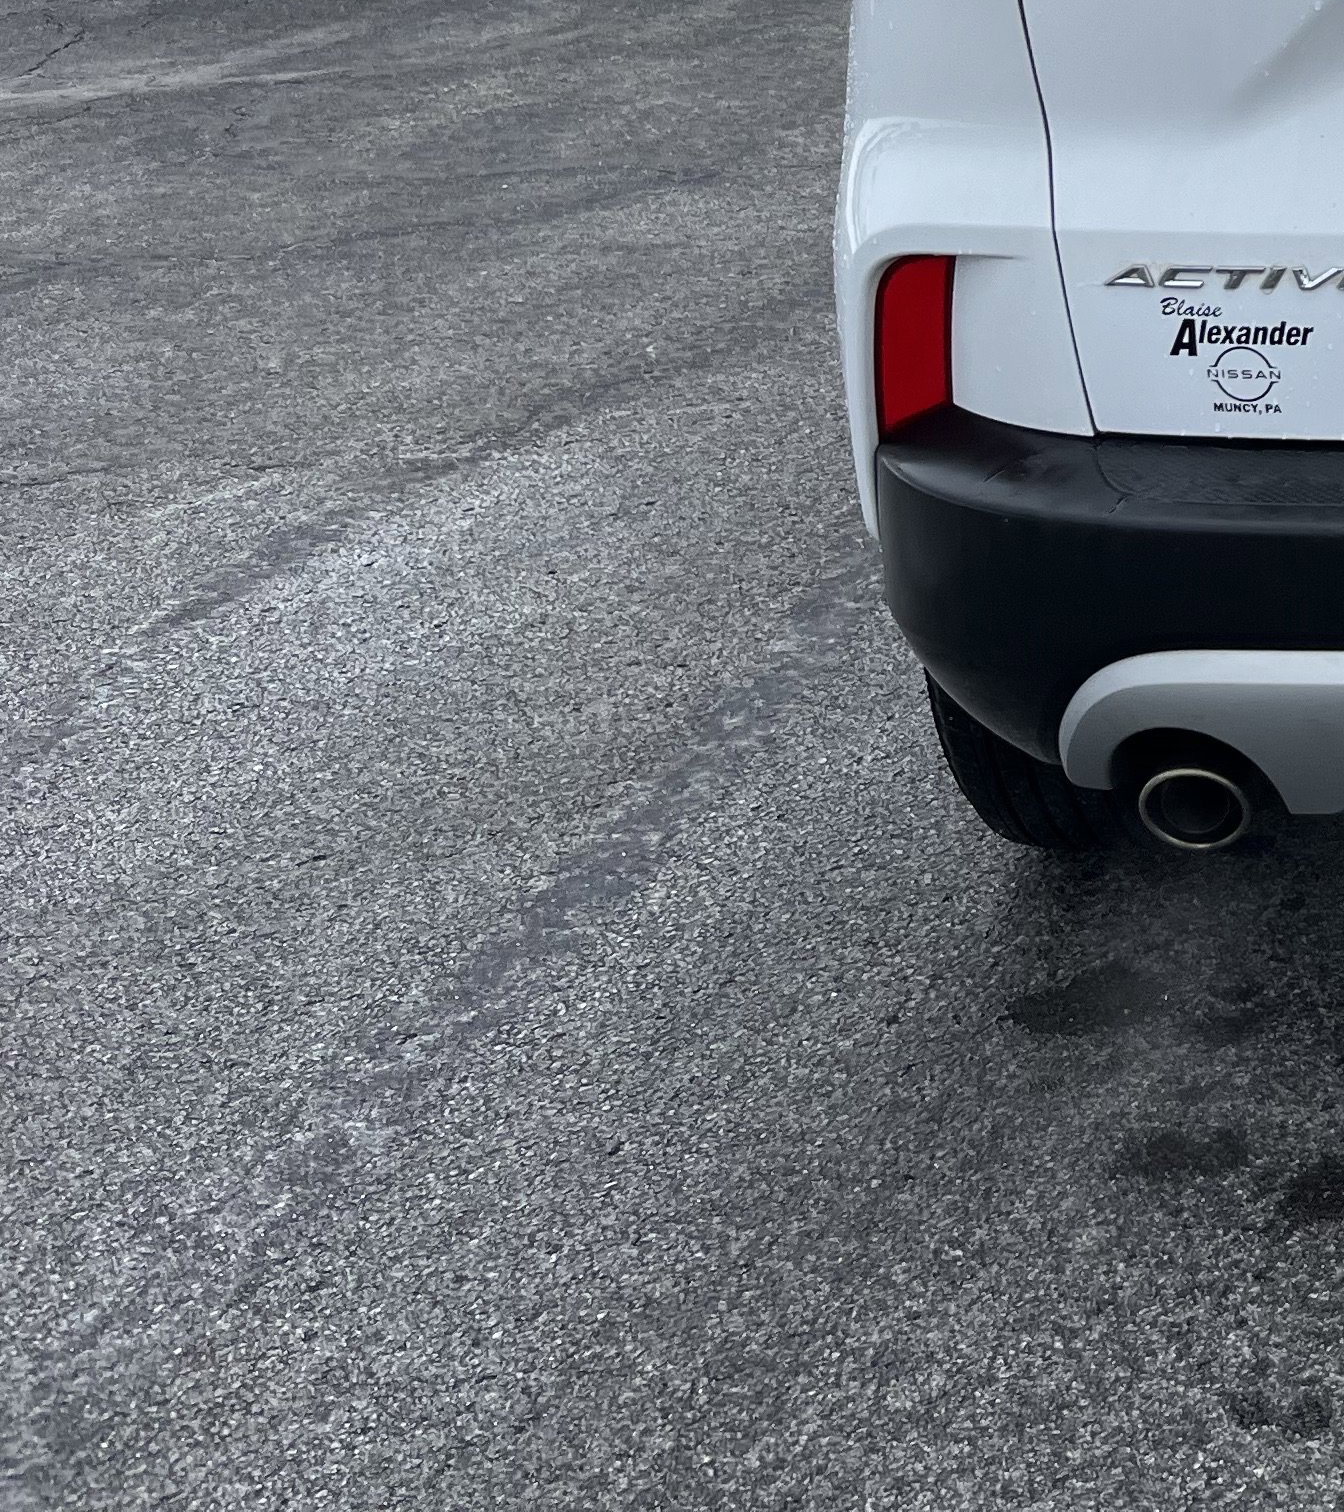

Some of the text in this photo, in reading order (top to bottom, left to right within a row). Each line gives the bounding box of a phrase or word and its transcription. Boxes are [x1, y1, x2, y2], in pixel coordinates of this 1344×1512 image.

[1159, 296, 1223, 318] Blaise
[1169, 318, 1315, 357] Alexander
[1206, 368, 1282, 381] NISSAN
[1213, 402, 1283, 415] MUNCY, PA
